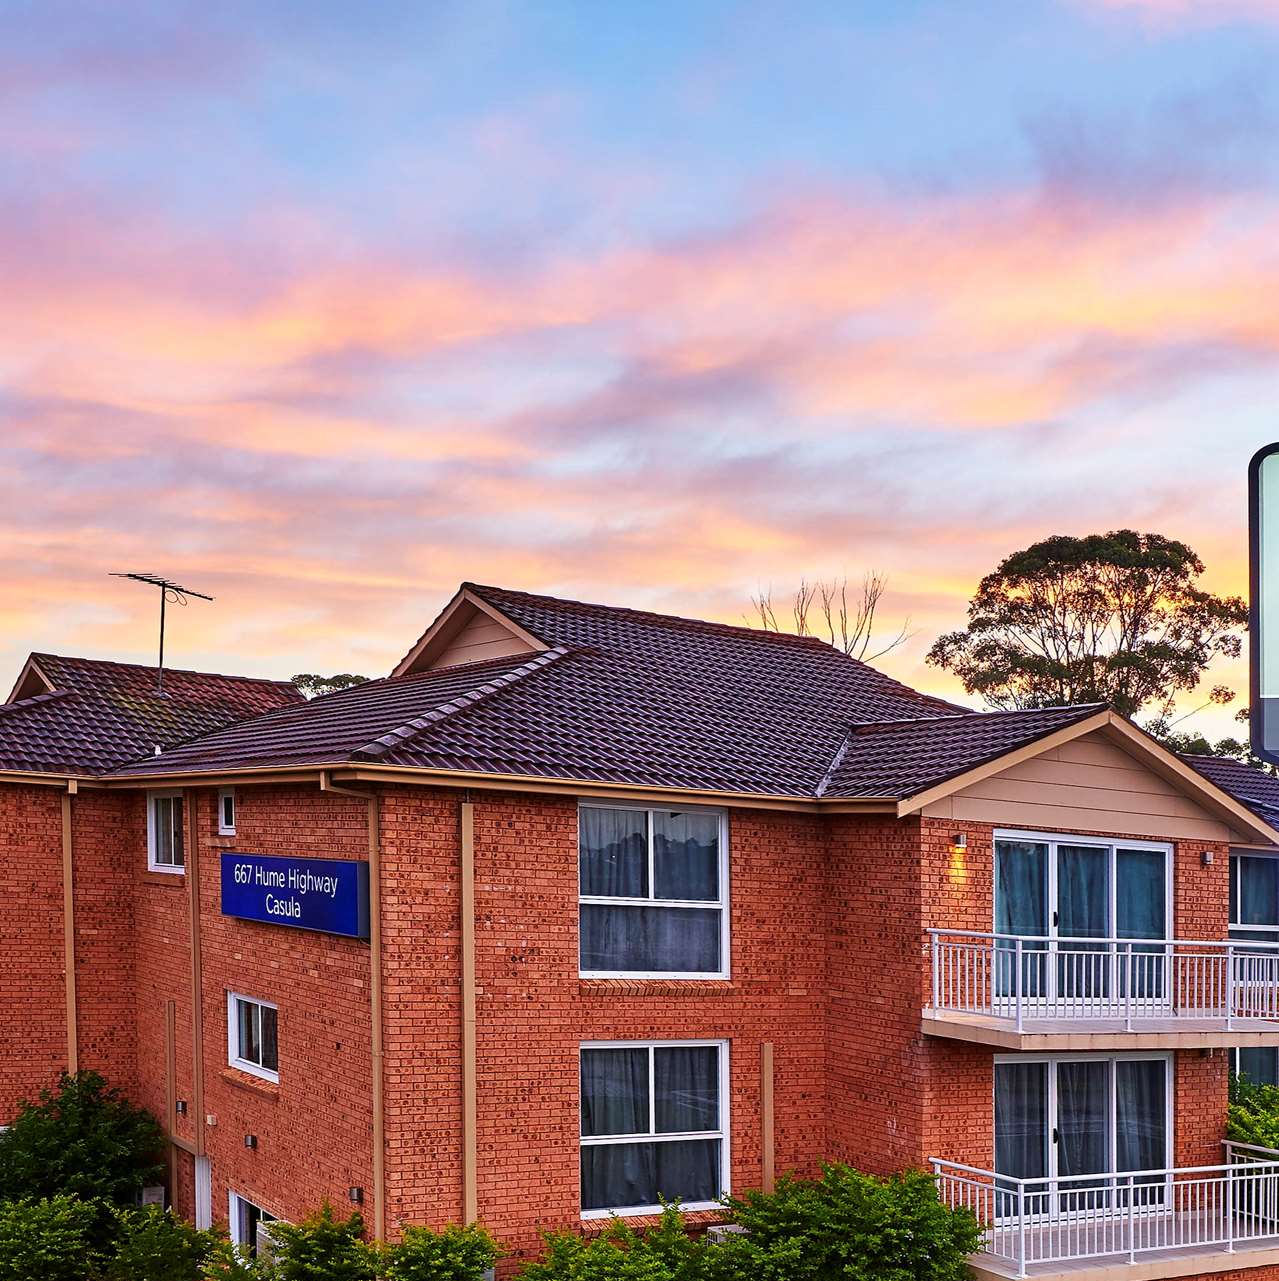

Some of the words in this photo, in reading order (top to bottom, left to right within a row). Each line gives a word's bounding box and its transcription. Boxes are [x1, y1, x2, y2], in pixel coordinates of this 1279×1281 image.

[234, 863, 253, 884] 667
[255, 866, 286, 888] Hume
[288, 868, 338, 898] Highway
[265, 893, 301, 918] Casula
